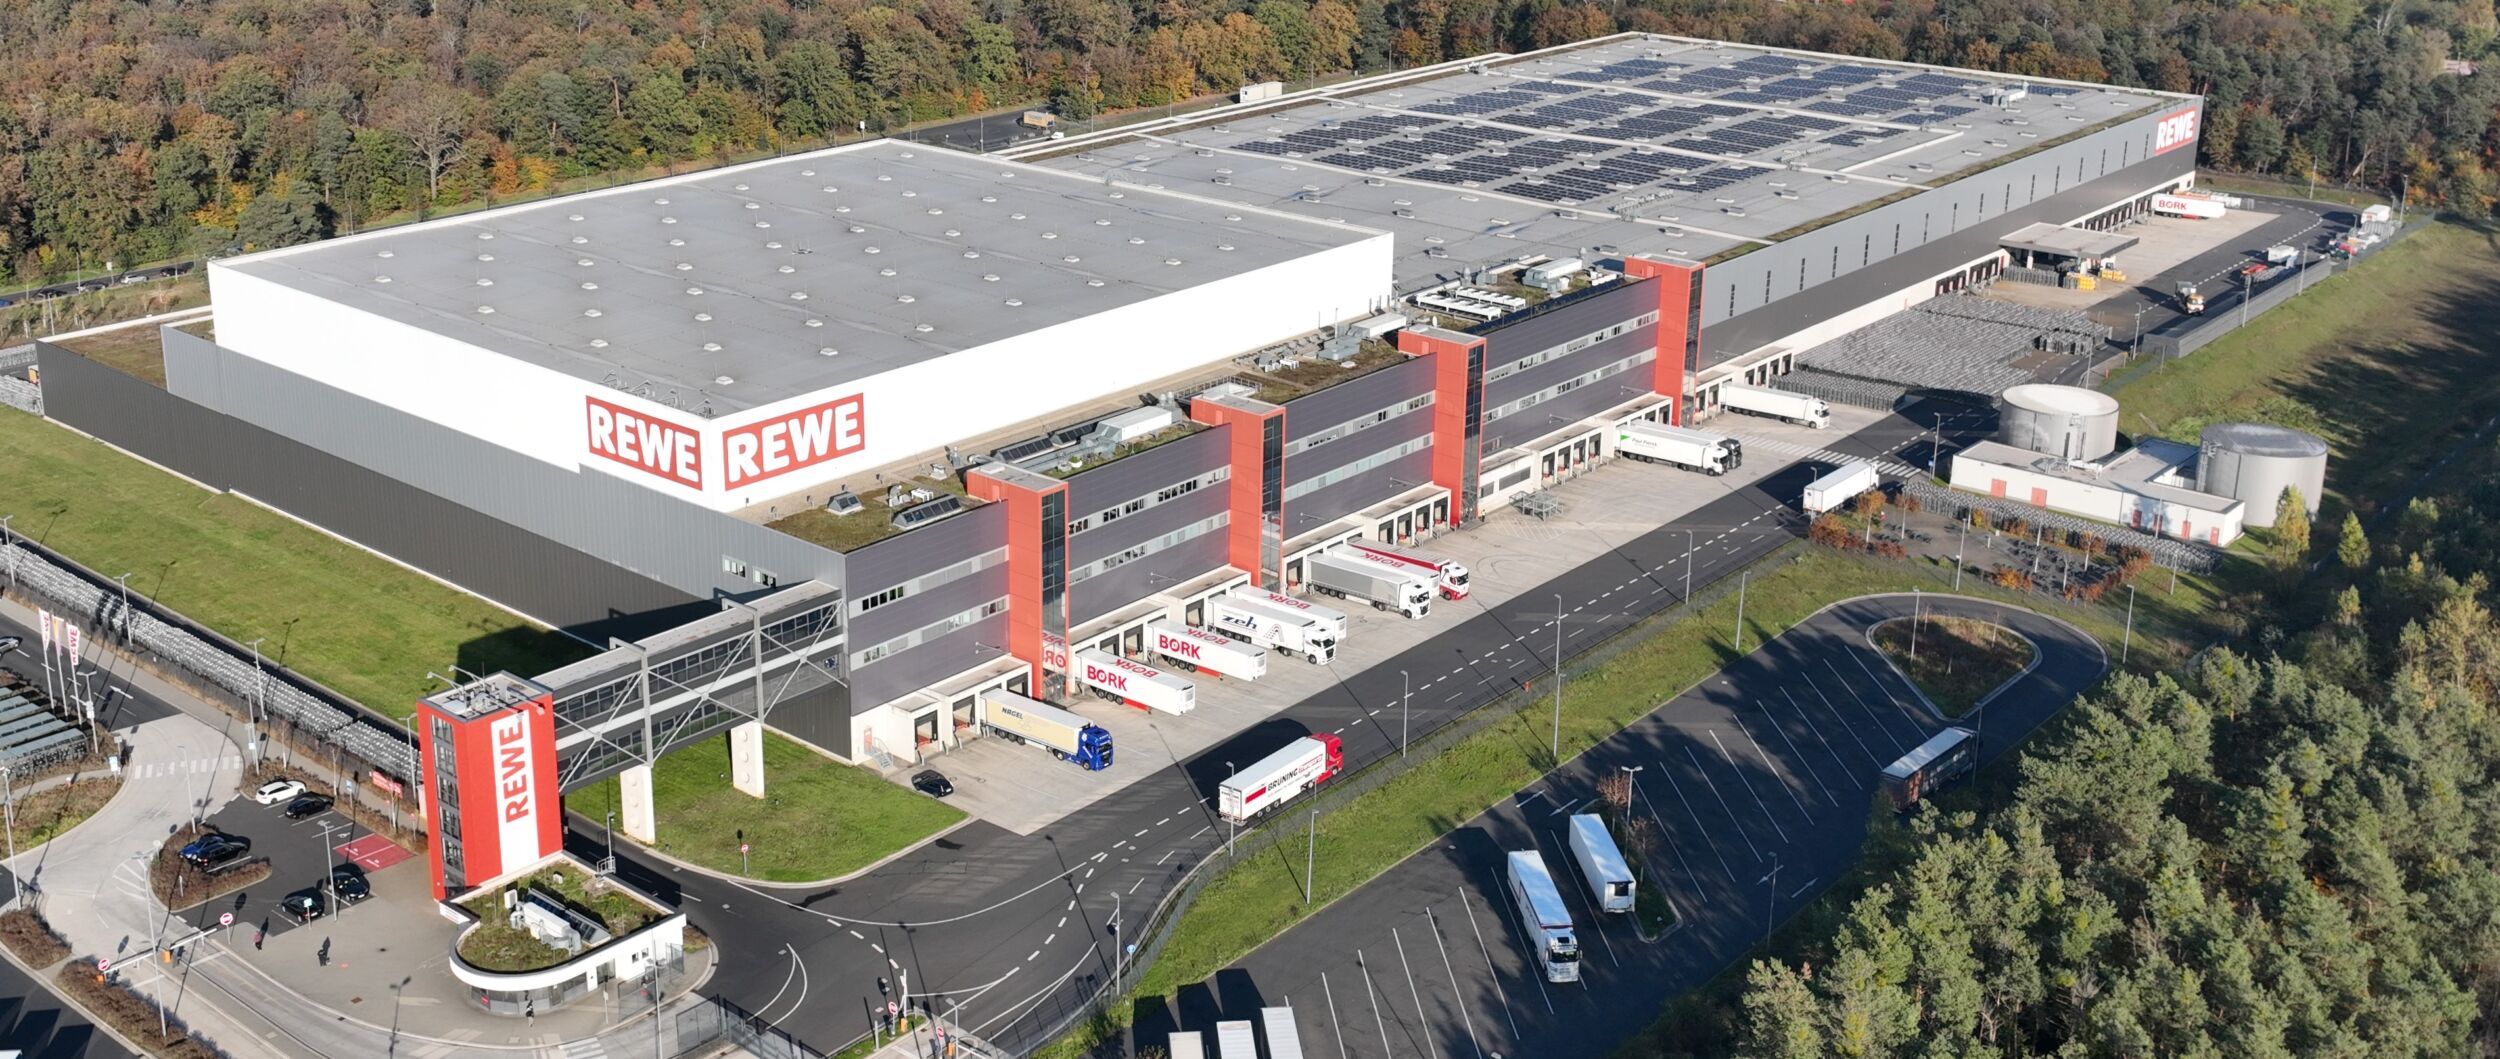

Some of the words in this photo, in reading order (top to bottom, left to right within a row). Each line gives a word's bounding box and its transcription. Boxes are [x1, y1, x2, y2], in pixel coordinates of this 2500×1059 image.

[2155, 110, 2195, 150] REWE
[2158, 199, 2187, 210] BORK
[589, 403, 699, 483] REWE
[727, 401, 861, 483] REWE
[1360, 553, 1405, 568] BORK
[1267, 593, 1311, 609] BORK
[1222, 615, 1257, 629] zeh
[1186, 629, 1230, 645] BORK
[1159, 634, 1200, 660] BORK
[1088, 665, 1127, 691] BORK
[1114, 659, 1159, 678] BORK
[1002, 707, 1023, 720] NAGEL
[499, 720, 529, 823] REWE
